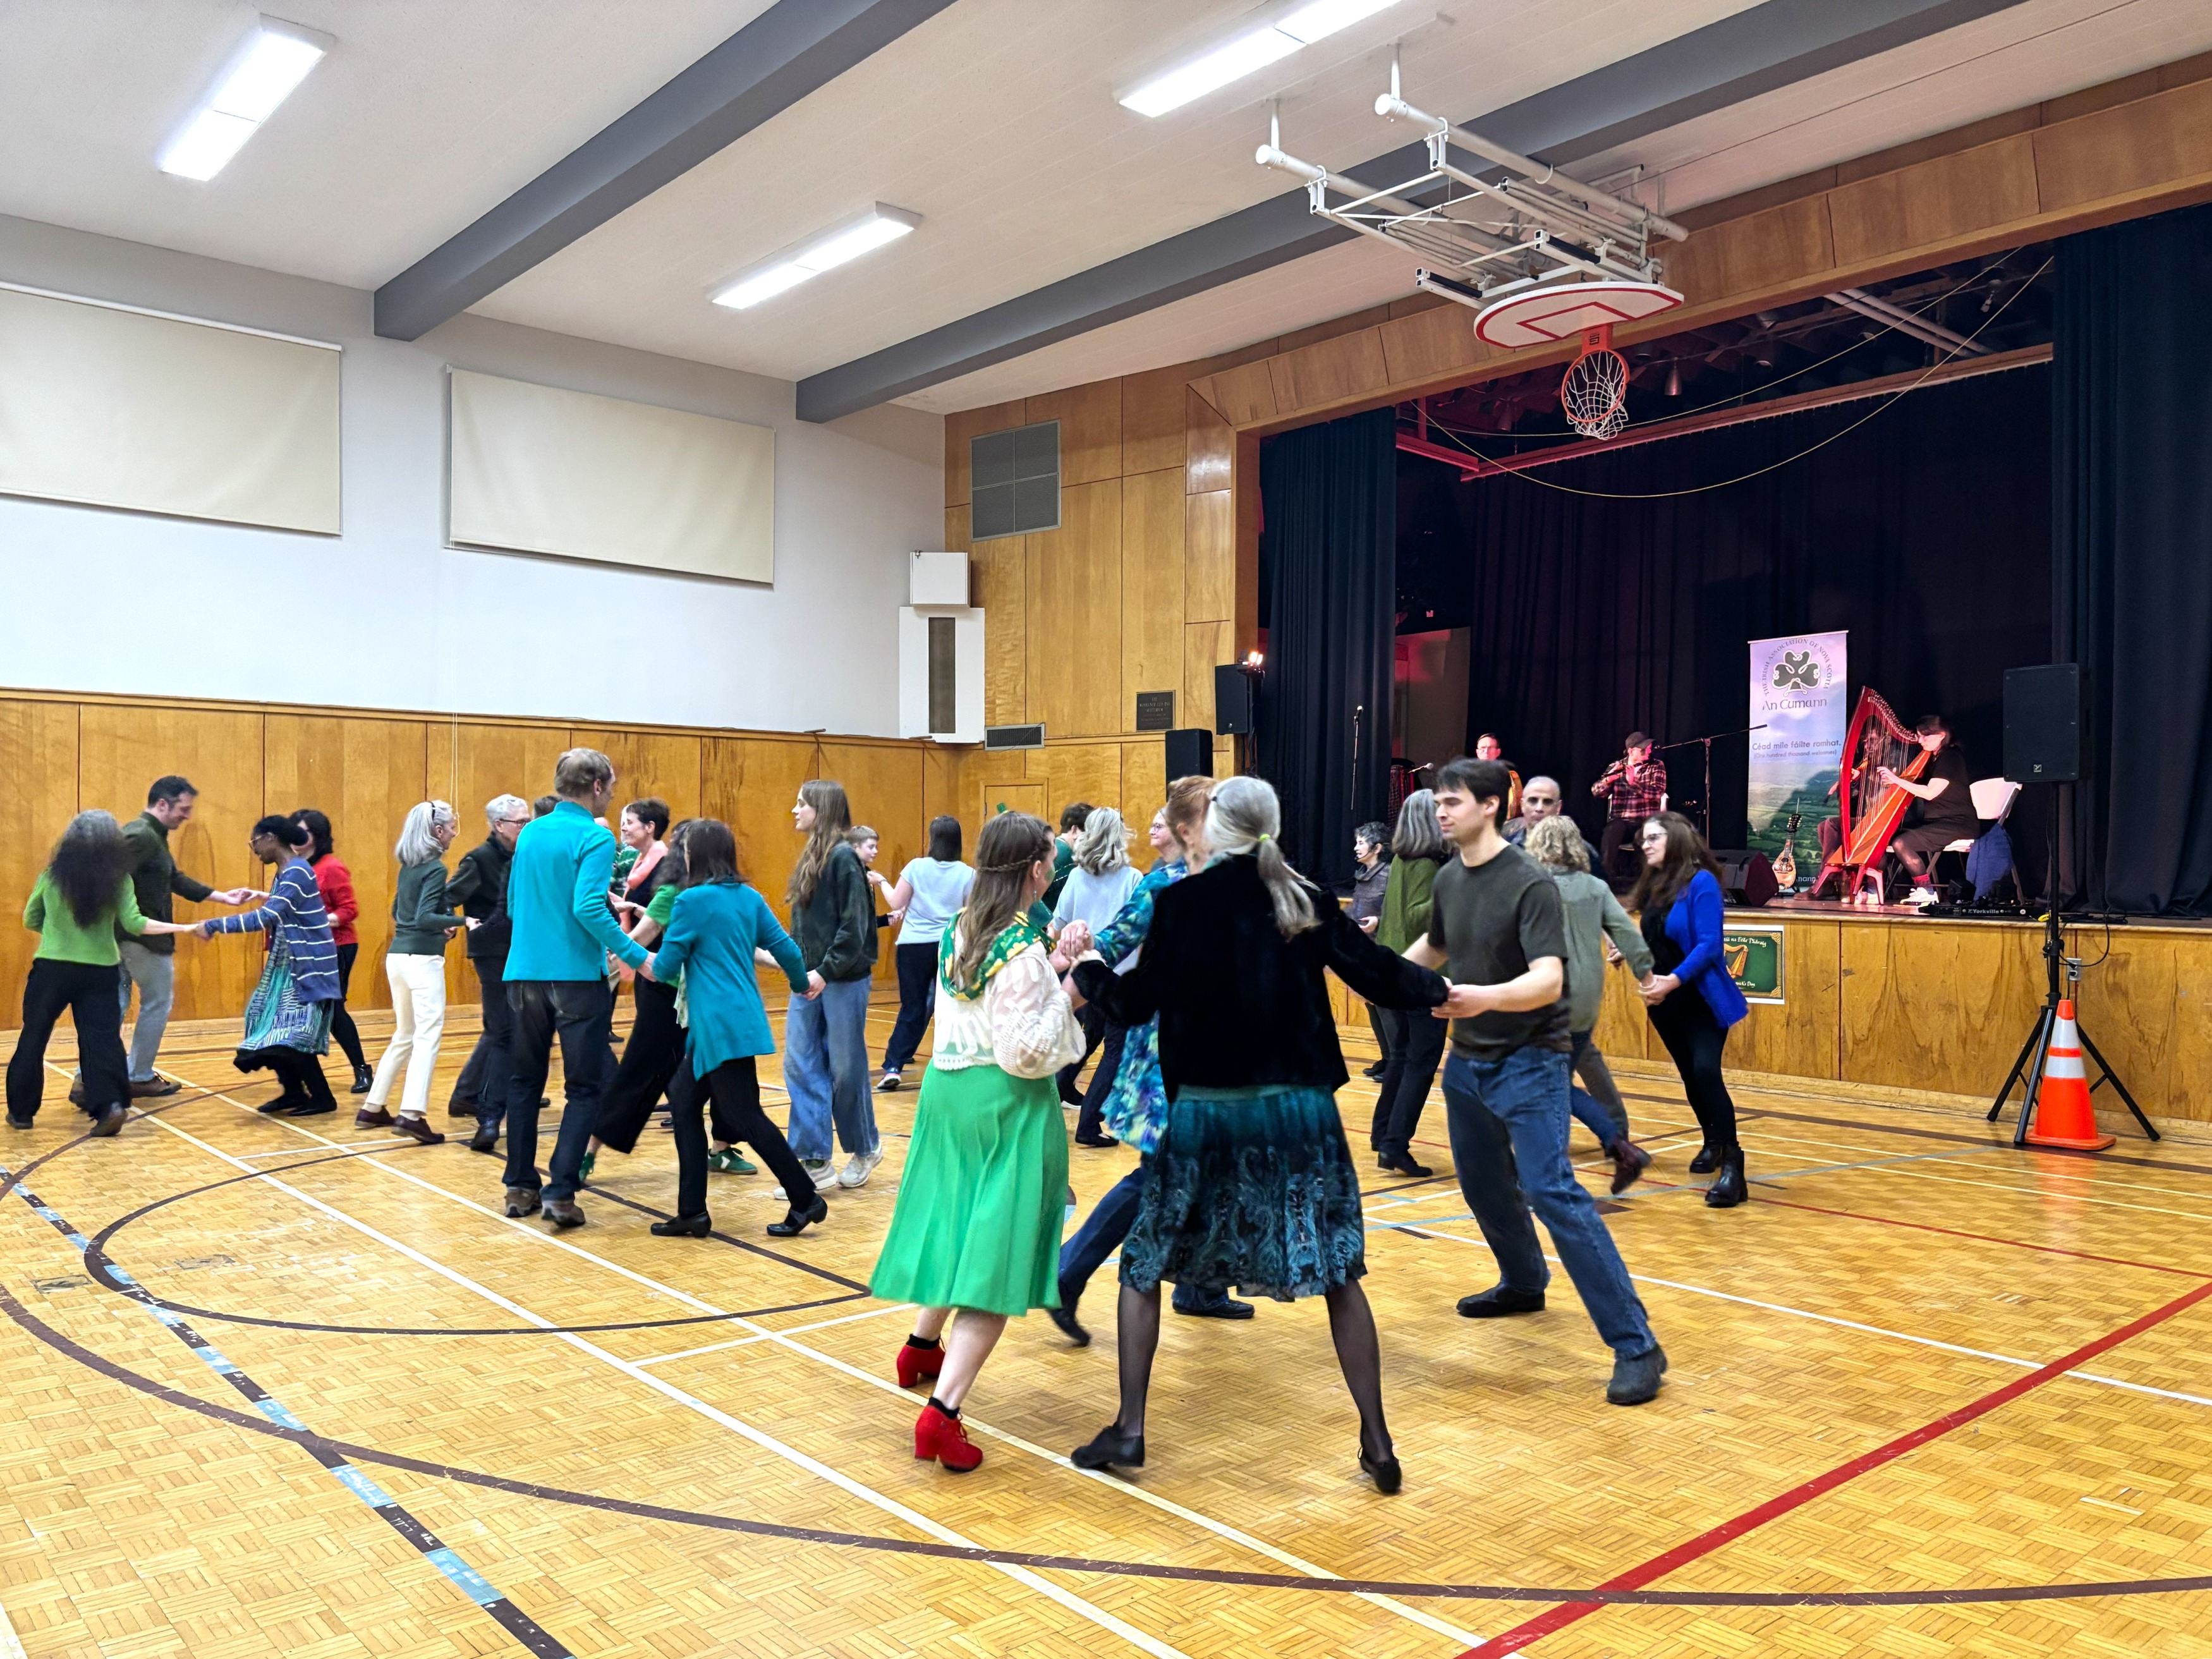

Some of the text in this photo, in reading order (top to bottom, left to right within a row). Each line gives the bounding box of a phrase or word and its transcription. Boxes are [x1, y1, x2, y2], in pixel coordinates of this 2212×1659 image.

[1768, 638, 1808, 661] ASSOCIATION
[1809, 640, 1820, 648] OF
[1818, 646, 1830, 663] NOVA
[1823, 664, 1832, 689] SCOTIA
[1762, 698, 1827, 710] An Cumann
[1813, 739, 1841, 747] romhat.
